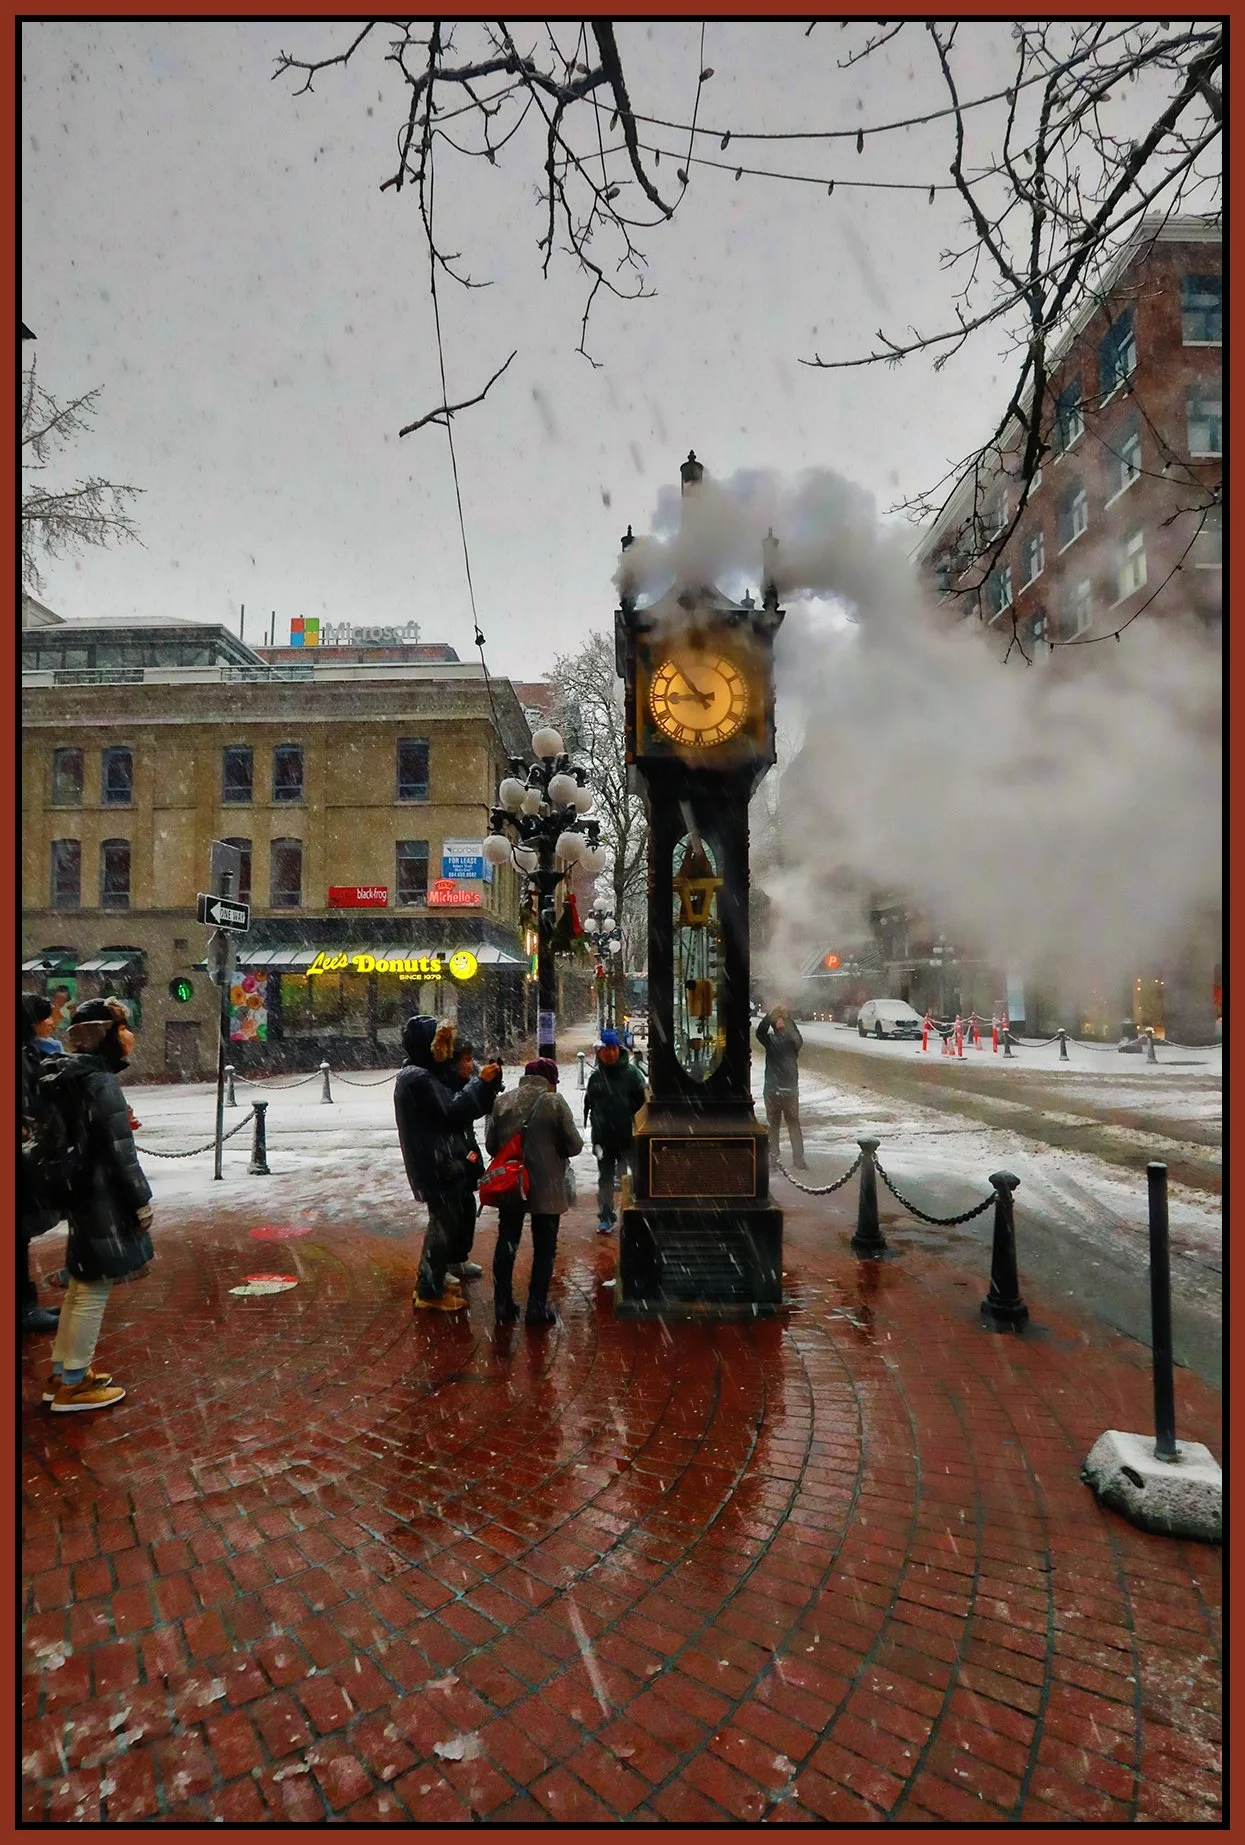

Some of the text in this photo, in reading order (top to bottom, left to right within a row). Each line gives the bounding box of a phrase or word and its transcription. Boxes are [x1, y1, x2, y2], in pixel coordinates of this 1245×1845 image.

[325, 620, 420, 641] Microsoft
[460, 857, 477, 865] LEASE
[429, 890, 480, 903] Michelle's
[220, 907, 246, 923] ONE WAY
[306, 951, 441, 976] Lee's Donuts
